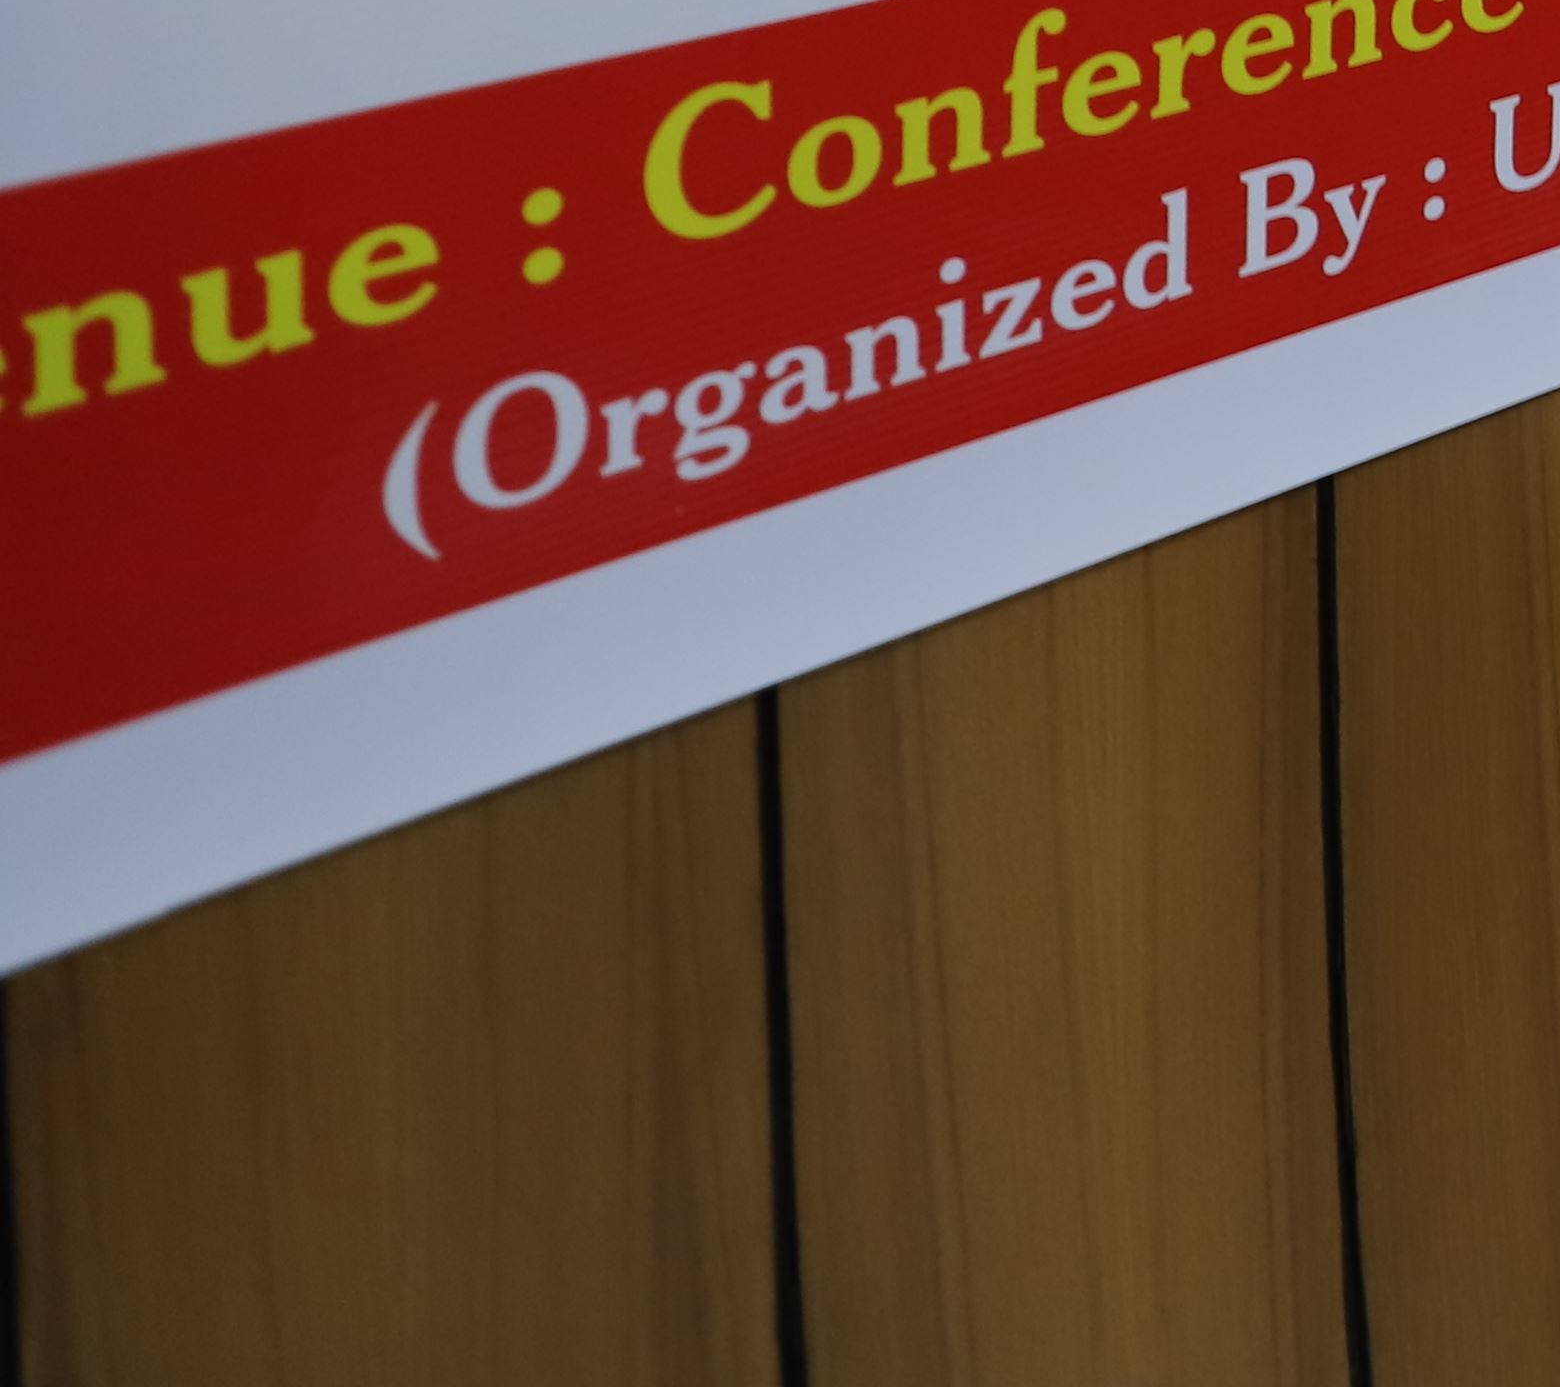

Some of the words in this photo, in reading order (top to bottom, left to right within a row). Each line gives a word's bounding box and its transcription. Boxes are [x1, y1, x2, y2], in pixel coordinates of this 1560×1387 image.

[0, 222, 441, 420] nue
[380, 188, 1193, 563] (Organized
[1237, 157, 1389, 279] By
